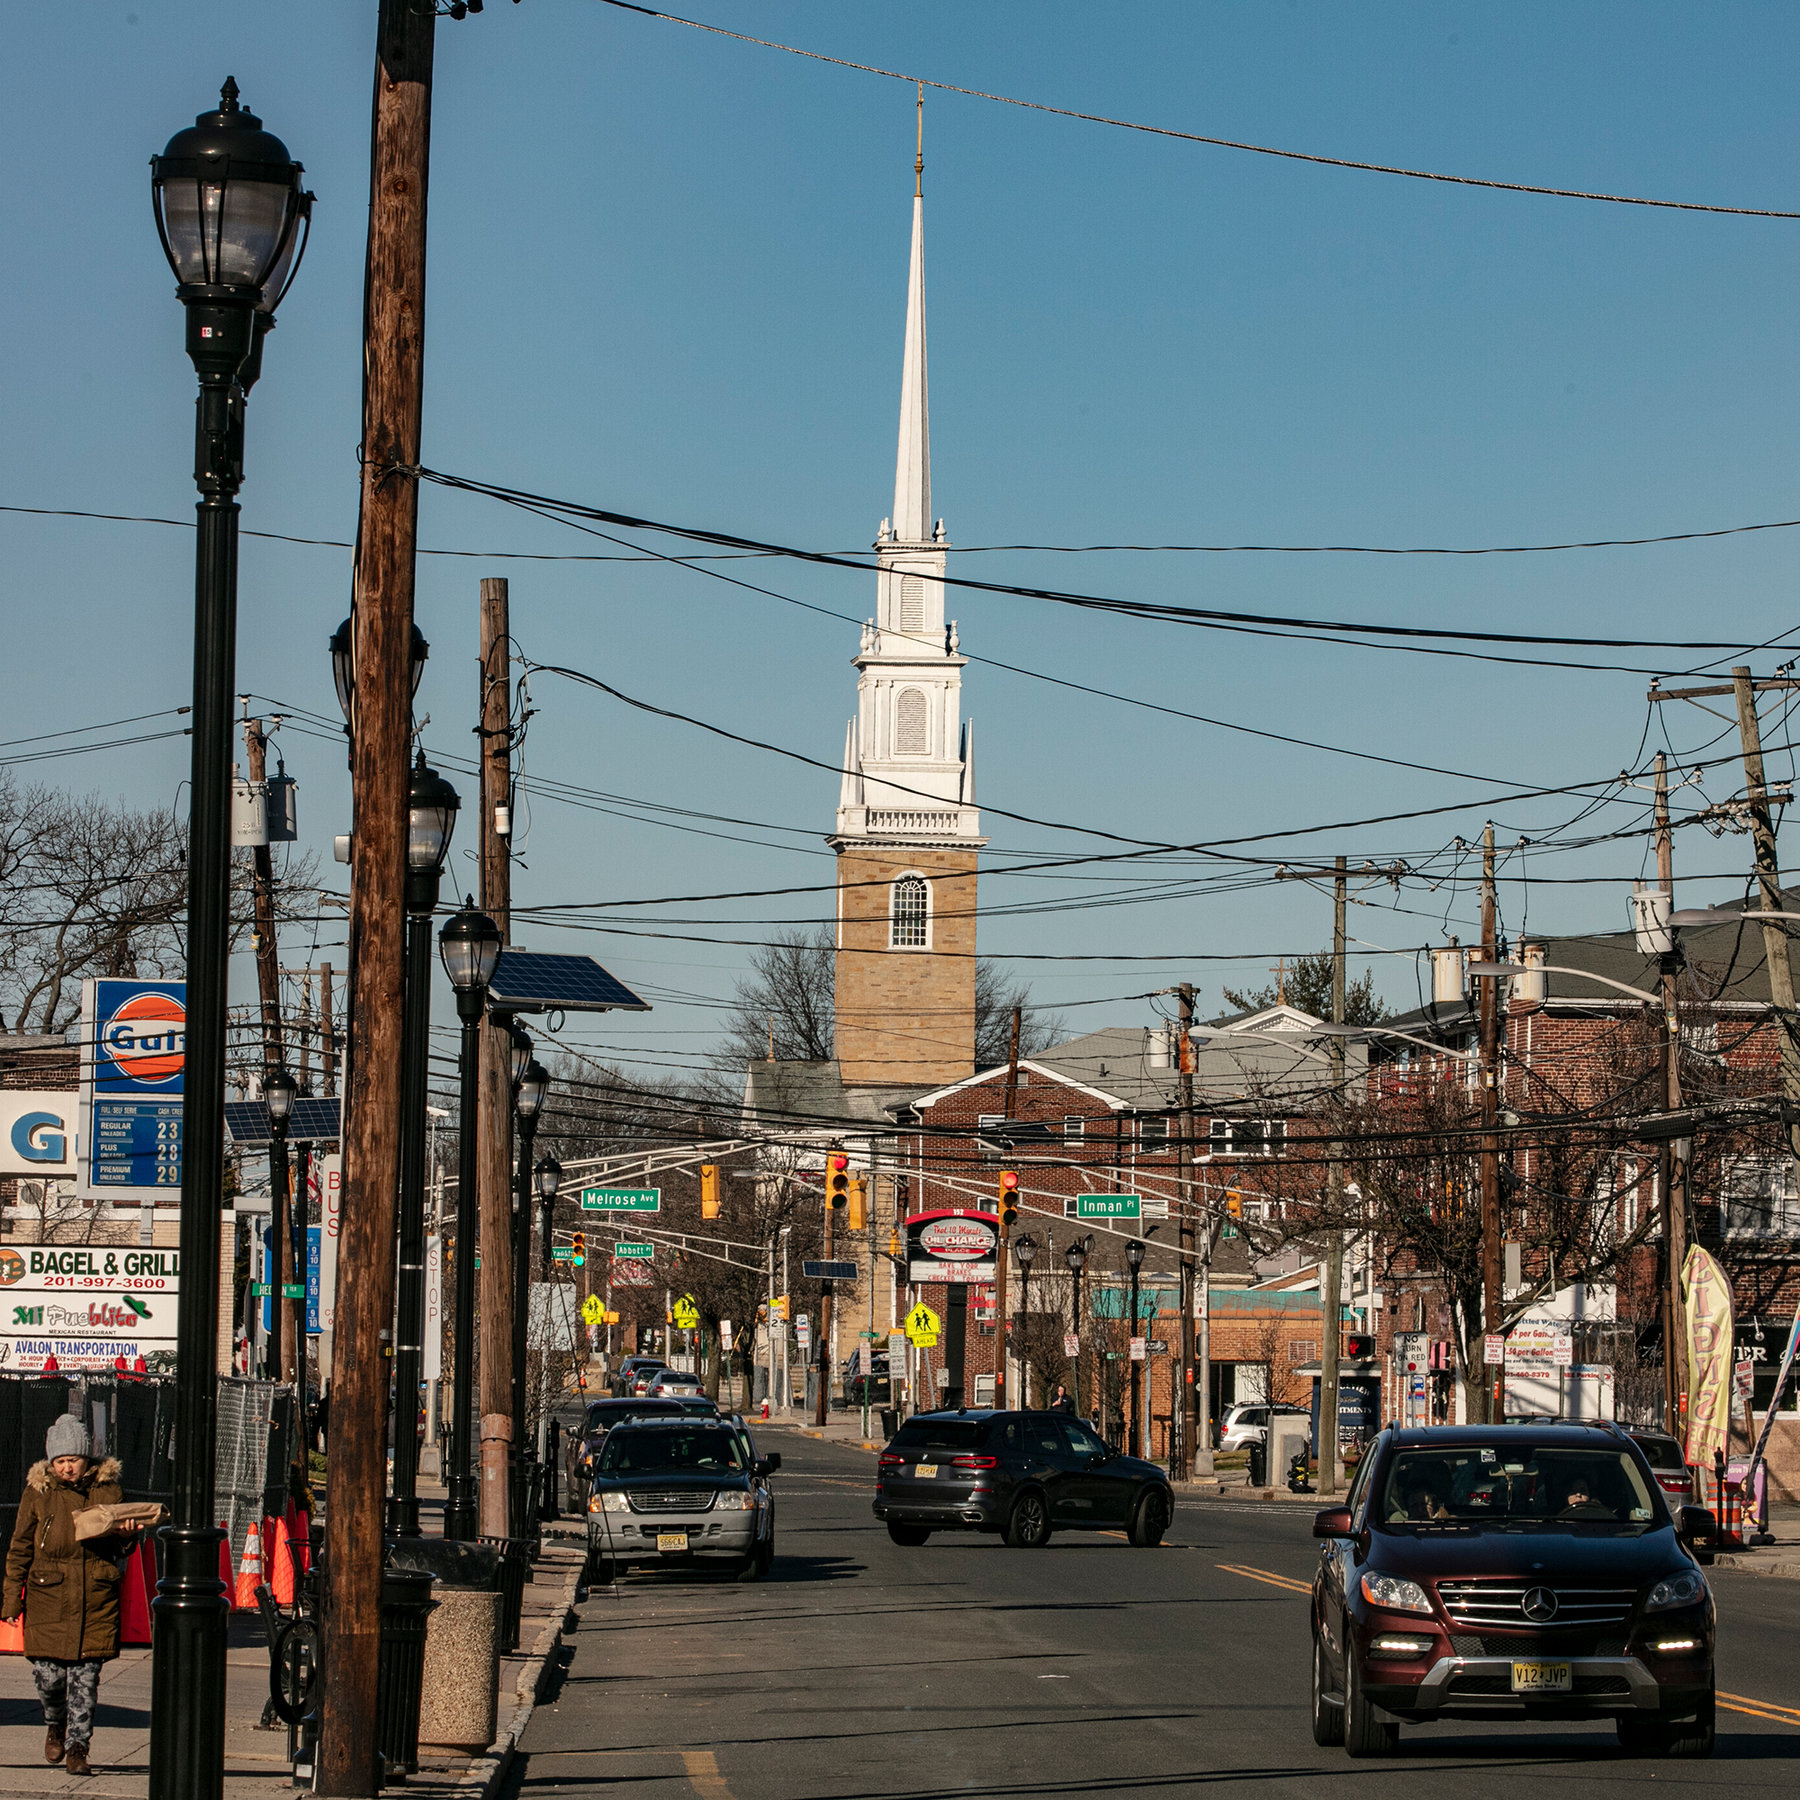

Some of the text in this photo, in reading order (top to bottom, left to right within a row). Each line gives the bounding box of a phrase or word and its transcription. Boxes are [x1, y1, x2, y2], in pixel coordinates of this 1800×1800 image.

[109, 1025, 185, 1051] Gul
[100, 1121, 131, 1130] REGULAR
[100, 1143, 117, 1151] PLUS
[100, 1166, 131, 1174] PREMIUM
[587, 1192, 654, 1206] Melrose Ave
[1084, 1200, 1135, 1212] Inman Pl
[924, 1236, 991, 1247] OIL CHANGE
[618, 1246, 644, 1255] Abbott
[30, 1251, 99, 1275] BAGEL
[104, 1252, 119, 1276] &
[124, 1253, 180, 1277] GRILL
[43, 1276, 165, 1289] 201-997-3600
[429, 1250, 438, 1322] STOP
[12, 1302, 138, 1327] Mi Pueblito
[916, 1336, 934, 1345] AHEAD
[1404, 1334, 1419, 1344] NO
[1558, 1338, 1567, 1347] NO
[15, 1341, 138, 1356] AVALON TRANSPORTATION
[1402, 1344, 1422, 1352] TURN
[1517, 1349, 1530, 1357] per
[1531, 1348, 1554, 1356] Gallon
[1398, 1353, 1426, 1362] ON RED
[1516, 1668, 1567, 1683] V12 JVP
